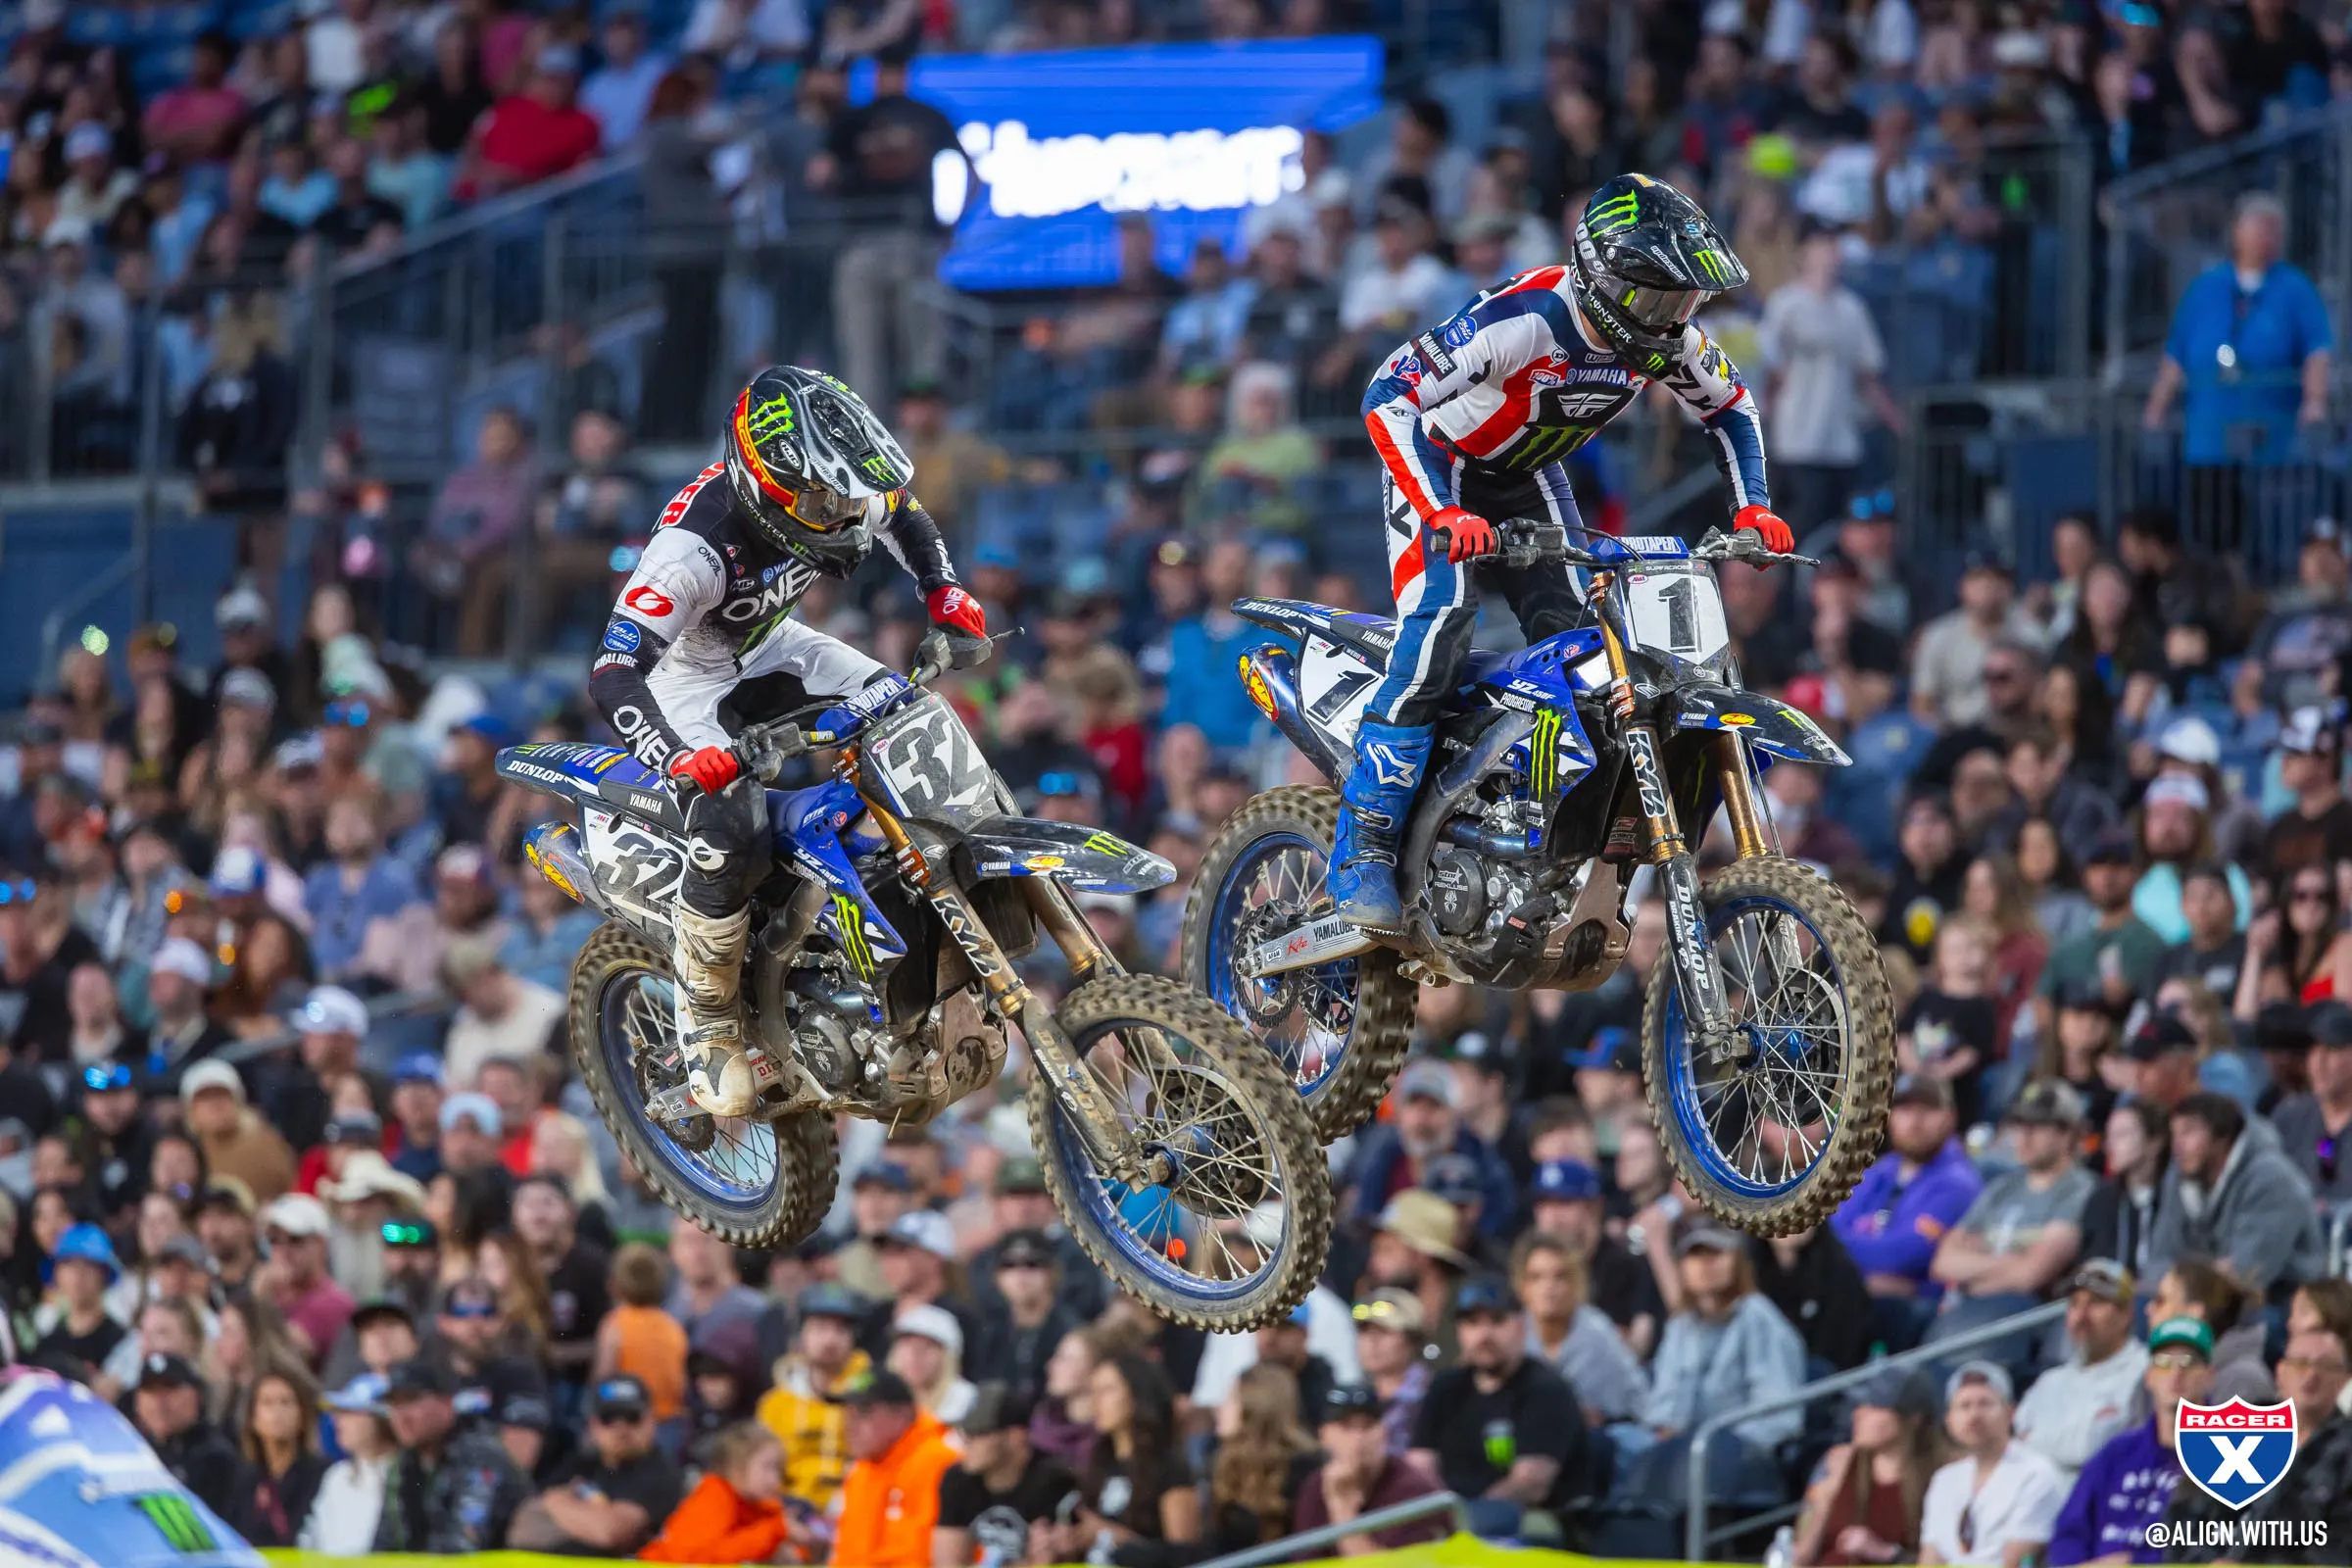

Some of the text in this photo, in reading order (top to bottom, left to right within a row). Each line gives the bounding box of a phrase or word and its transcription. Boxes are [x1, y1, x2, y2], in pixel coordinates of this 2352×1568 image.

[1419, 331, 1453, 375] YAMALUBE
[1532, 370, 1559, 386] 100%
[1577, 368, 1628, 385] YAMAHA
[737, 415, 772, 485] SCOTT
[781, 442, 800, 467] HJC
[1622, 536, 1677, 553] PROTAPER
[722, 564, 821, 621] ONE
[1242, 602, 1298, 619] DUNLOP
[1658, 578, 1703, 654] 1
[1305, 669, 1380, 727] 1
[1507, 679, 1540, 695] YZ
[1499, 692, 1538, 714] PROGRESSIVE
[507, 760, 565, 784] DUNLOP
[889, 711, 987, 809] 32
[630, 793, 662, 814] YAMAHA
[794, 848, 823, 870] YZ
[988, 861, 1010, 871] YAMAHA
[593, 833, 684, 919] 32
[1669, 901, 1684, 944] BRAKING
[1676, 883, 1710, 991] DUNLOP
